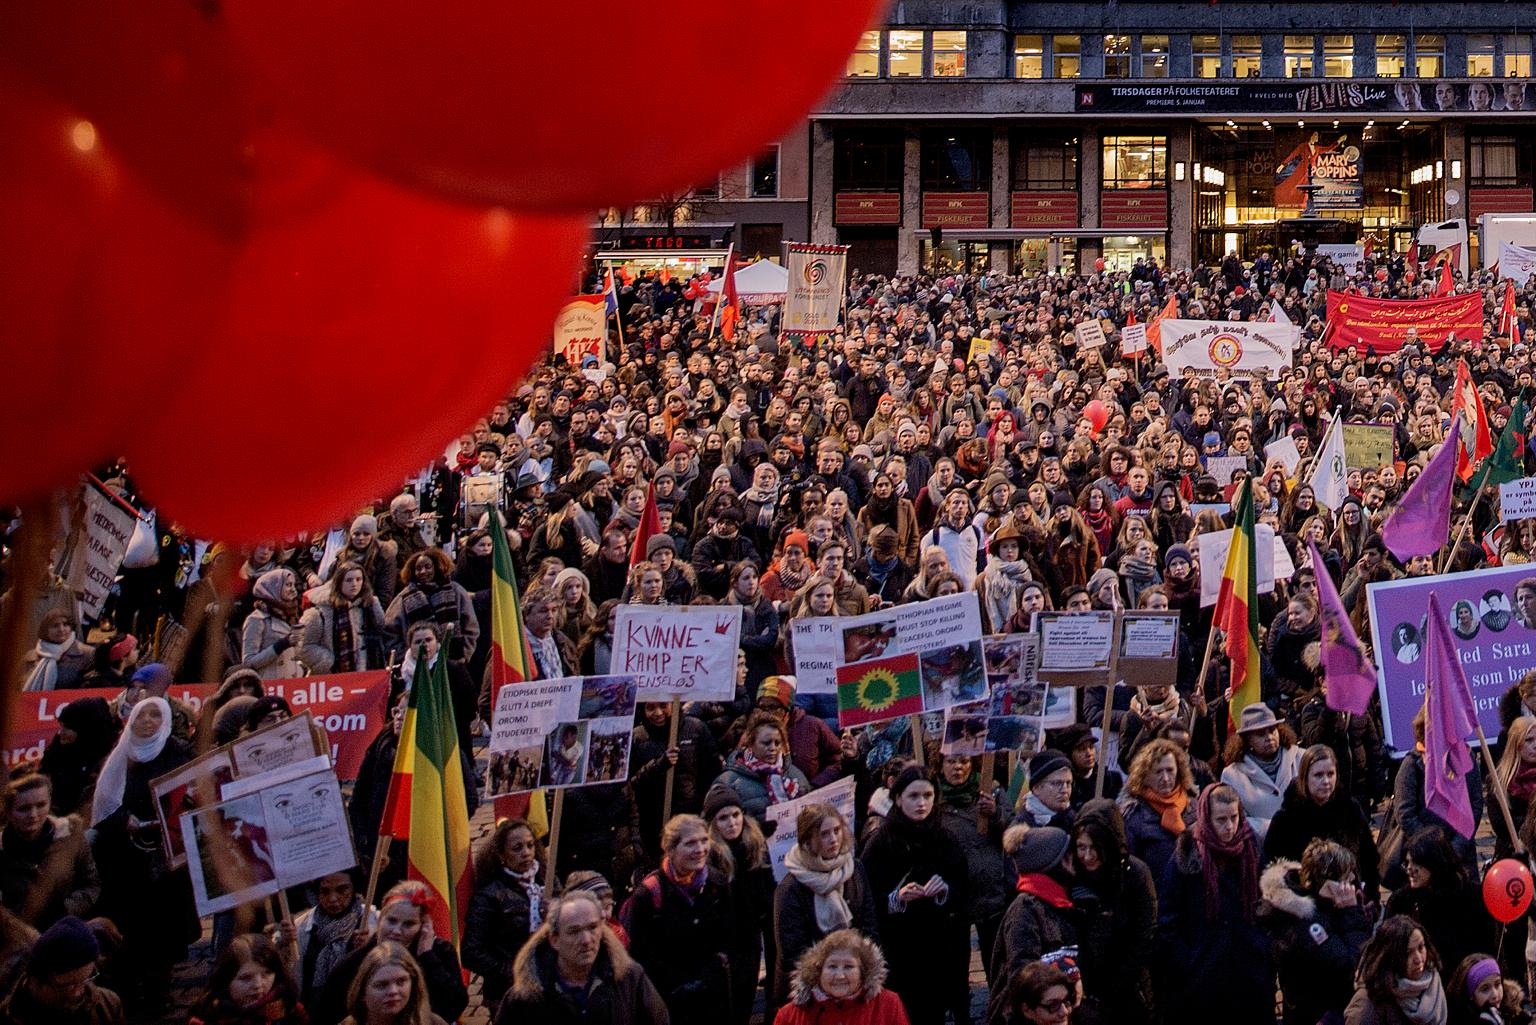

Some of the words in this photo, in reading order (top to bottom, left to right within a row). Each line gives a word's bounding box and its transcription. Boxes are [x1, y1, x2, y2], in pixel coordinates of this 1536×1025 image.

[1112, 88, 1162, 96] TIRSDAGER
[1163, 86, 1174, 96] PÅ
[1175, 87, 1240, 96] FOLKETEATERET
[1365, 88, 1386, 100] Live
[1146, 98, 1175, 106] PREMIERE
[1182, 98, 1205, 106] JANUAR
[1317, 154, 1350, 167] MARY
[1311, 164, 1359, 178] POPPINS
[1519, 481, 1534, 489] YPJ
[1523, 498, 1533, 506] på
[896, 606, 934, 622] ETHIOPIAN
[936, 601, 963, 613] REGIME
[898, 621, 918, 633] MUST
[920, 617, 938, 628] STOP
[939, 611, 966, 624] KILLING
[796, 624, 812, 634] THE
[935, 624, 964, 638] OROMO
[1458, 647, 1481, 664] ed
[1493, 641, 1531, 660] Sara
[625, 650, 672, 674] KAMP
[681, 655, 709, 675] ER
[800, 661, 833, 670] REGIME
[638, 675, 696, 689] ENSELØS
[1472, 671, 1503, 688] som
[291, 682, 344, 705] alle
[503, 688, 539, 698] ETIOPISKE
[540, 685, 573, 694] REGIMET
[500, 702, 522, 712] SLUTT
[524, 700, 529, 709] Å
[531, 699, 553, 708] DREPE
[314, 714, 366, 732] som
[498, 716, 529, 725] OROMO
[778, 809, 790, 818] THE
